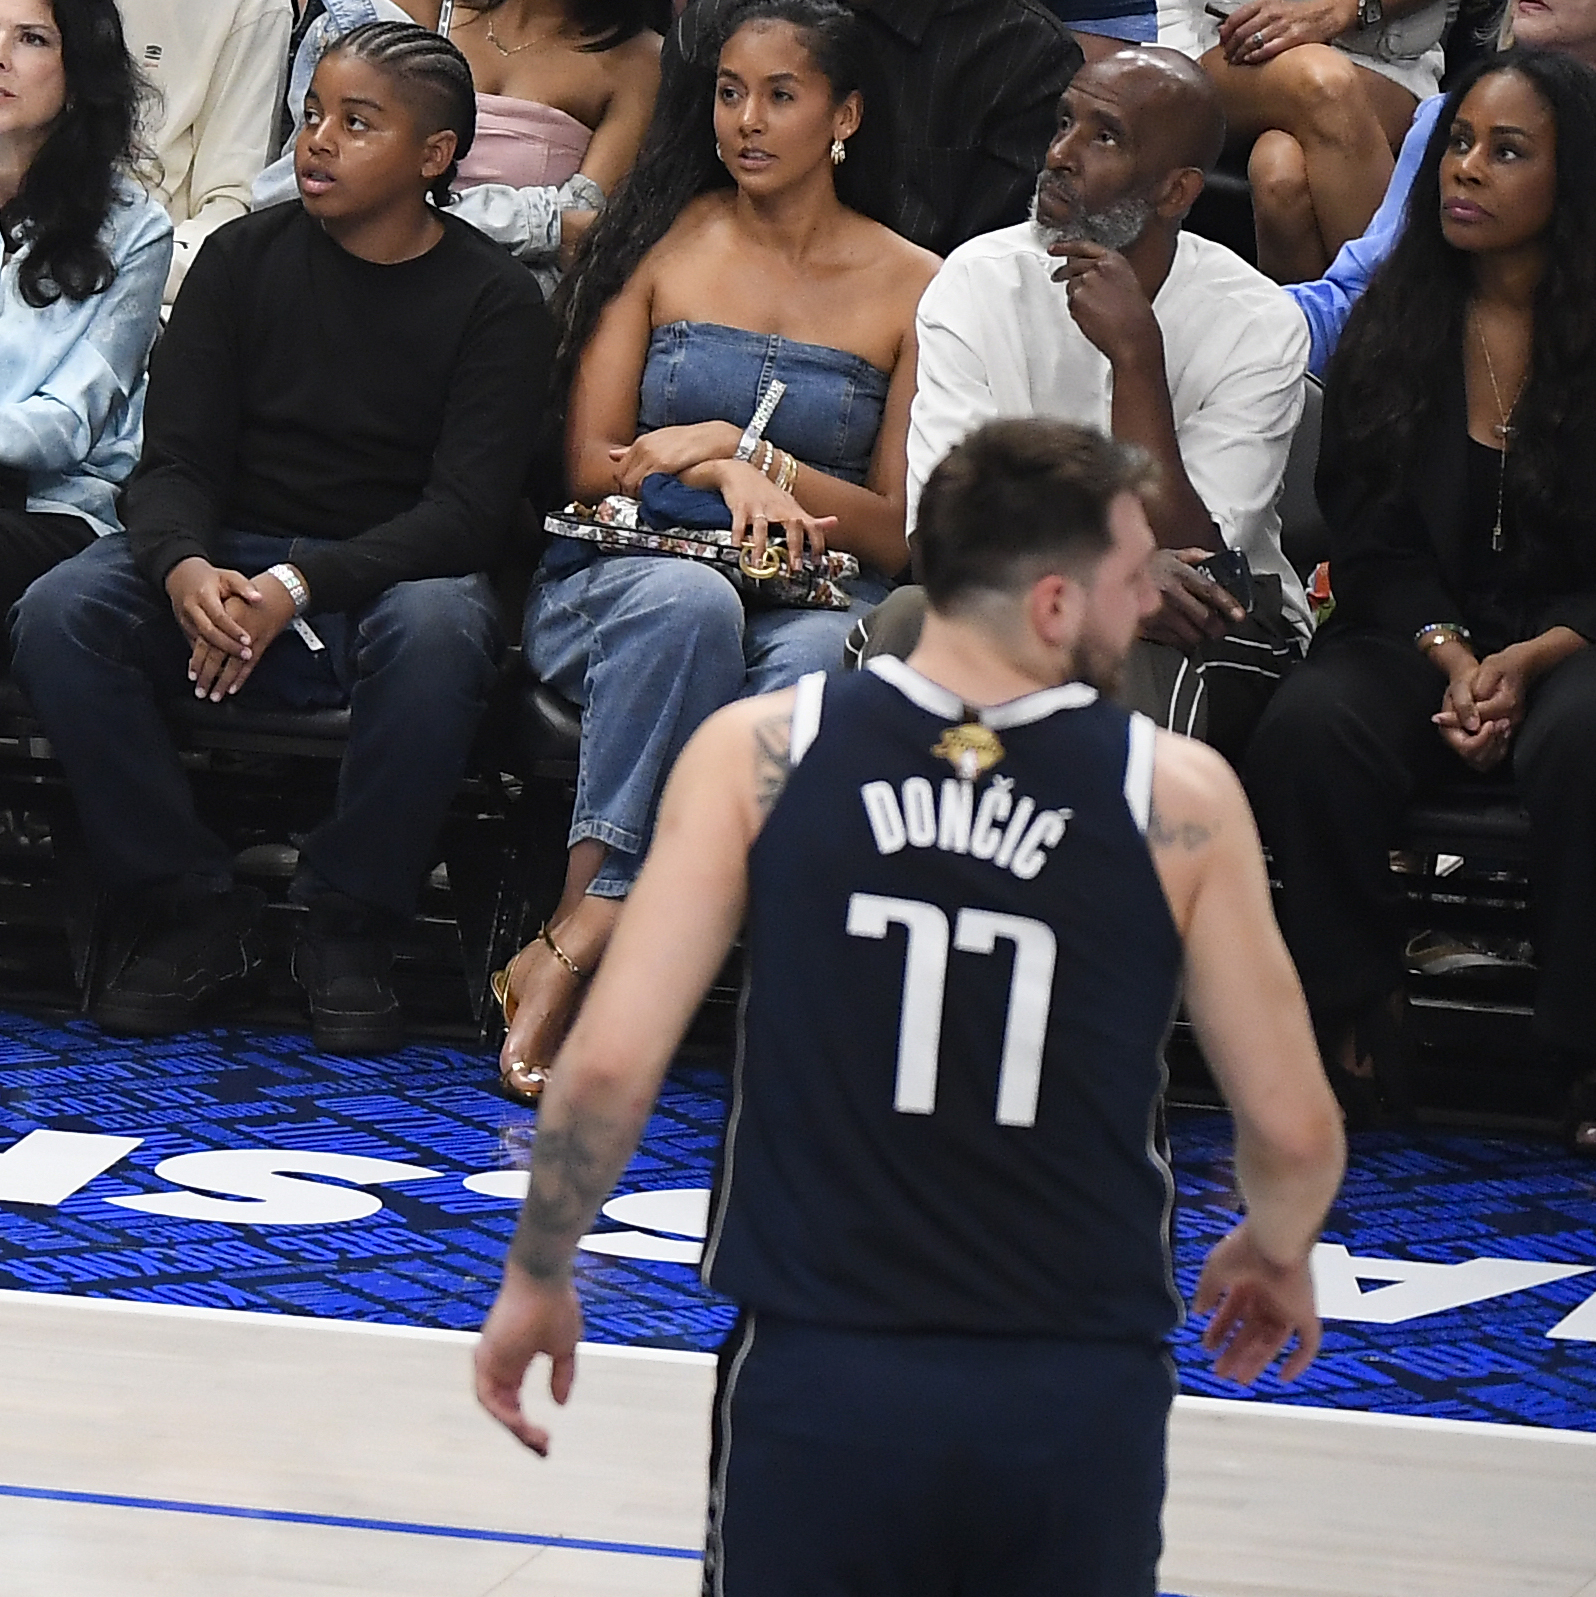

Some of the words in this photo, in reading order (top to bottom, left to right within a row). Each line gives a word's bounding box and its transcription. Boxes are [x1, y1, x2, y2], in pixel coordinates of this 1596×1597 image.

[860, 774, 1074, 881] DONČIĆ
[846, 891, 1058, 1129] 77
[136, 1054, 244, 1076] TOM
[7, 1090, 137, 1117] LEVER
[131, 1085, 220, 1108] FAT
[80, 1108, 205, 1128] BUTLER
[263, 1226, 447, 1266] GREG
